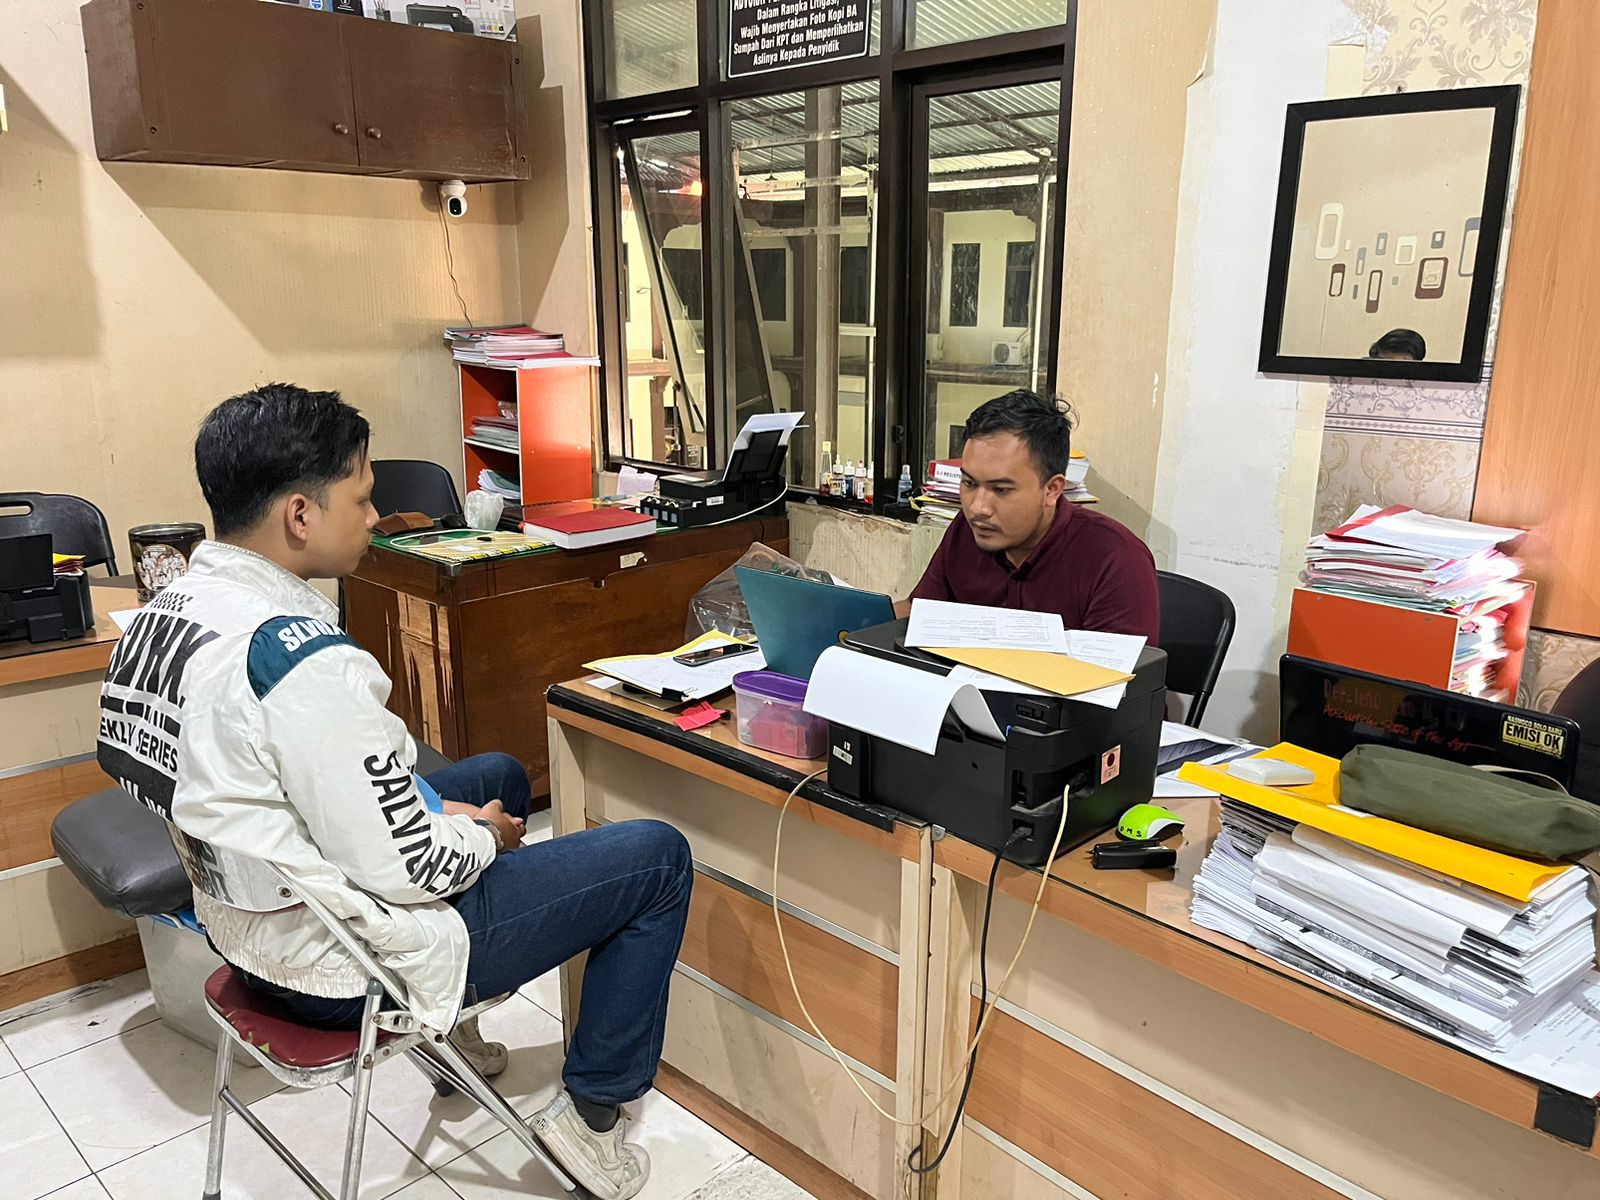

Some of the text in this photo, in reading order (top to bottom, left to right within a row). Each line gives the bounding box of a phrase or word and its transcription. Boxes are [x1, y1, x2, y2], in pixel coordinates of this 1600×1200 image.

[740, 4, 858, 39] Wajib Menyertakan Foto Kopi BA
[757, 7, 779, 20] Dalam
[781, 1, 807, 15] Rangka
[733, 21, 864, 54] Sumpah Dari KPT dan Memperlihatkan
[753, 40, 840, 66] Aslinya Kepada Penyidik
[135, 728, 178, 773] SERIES
[1505, 723, 1541, 744] EMISI
[1543, 733, 1561, 750] OK
